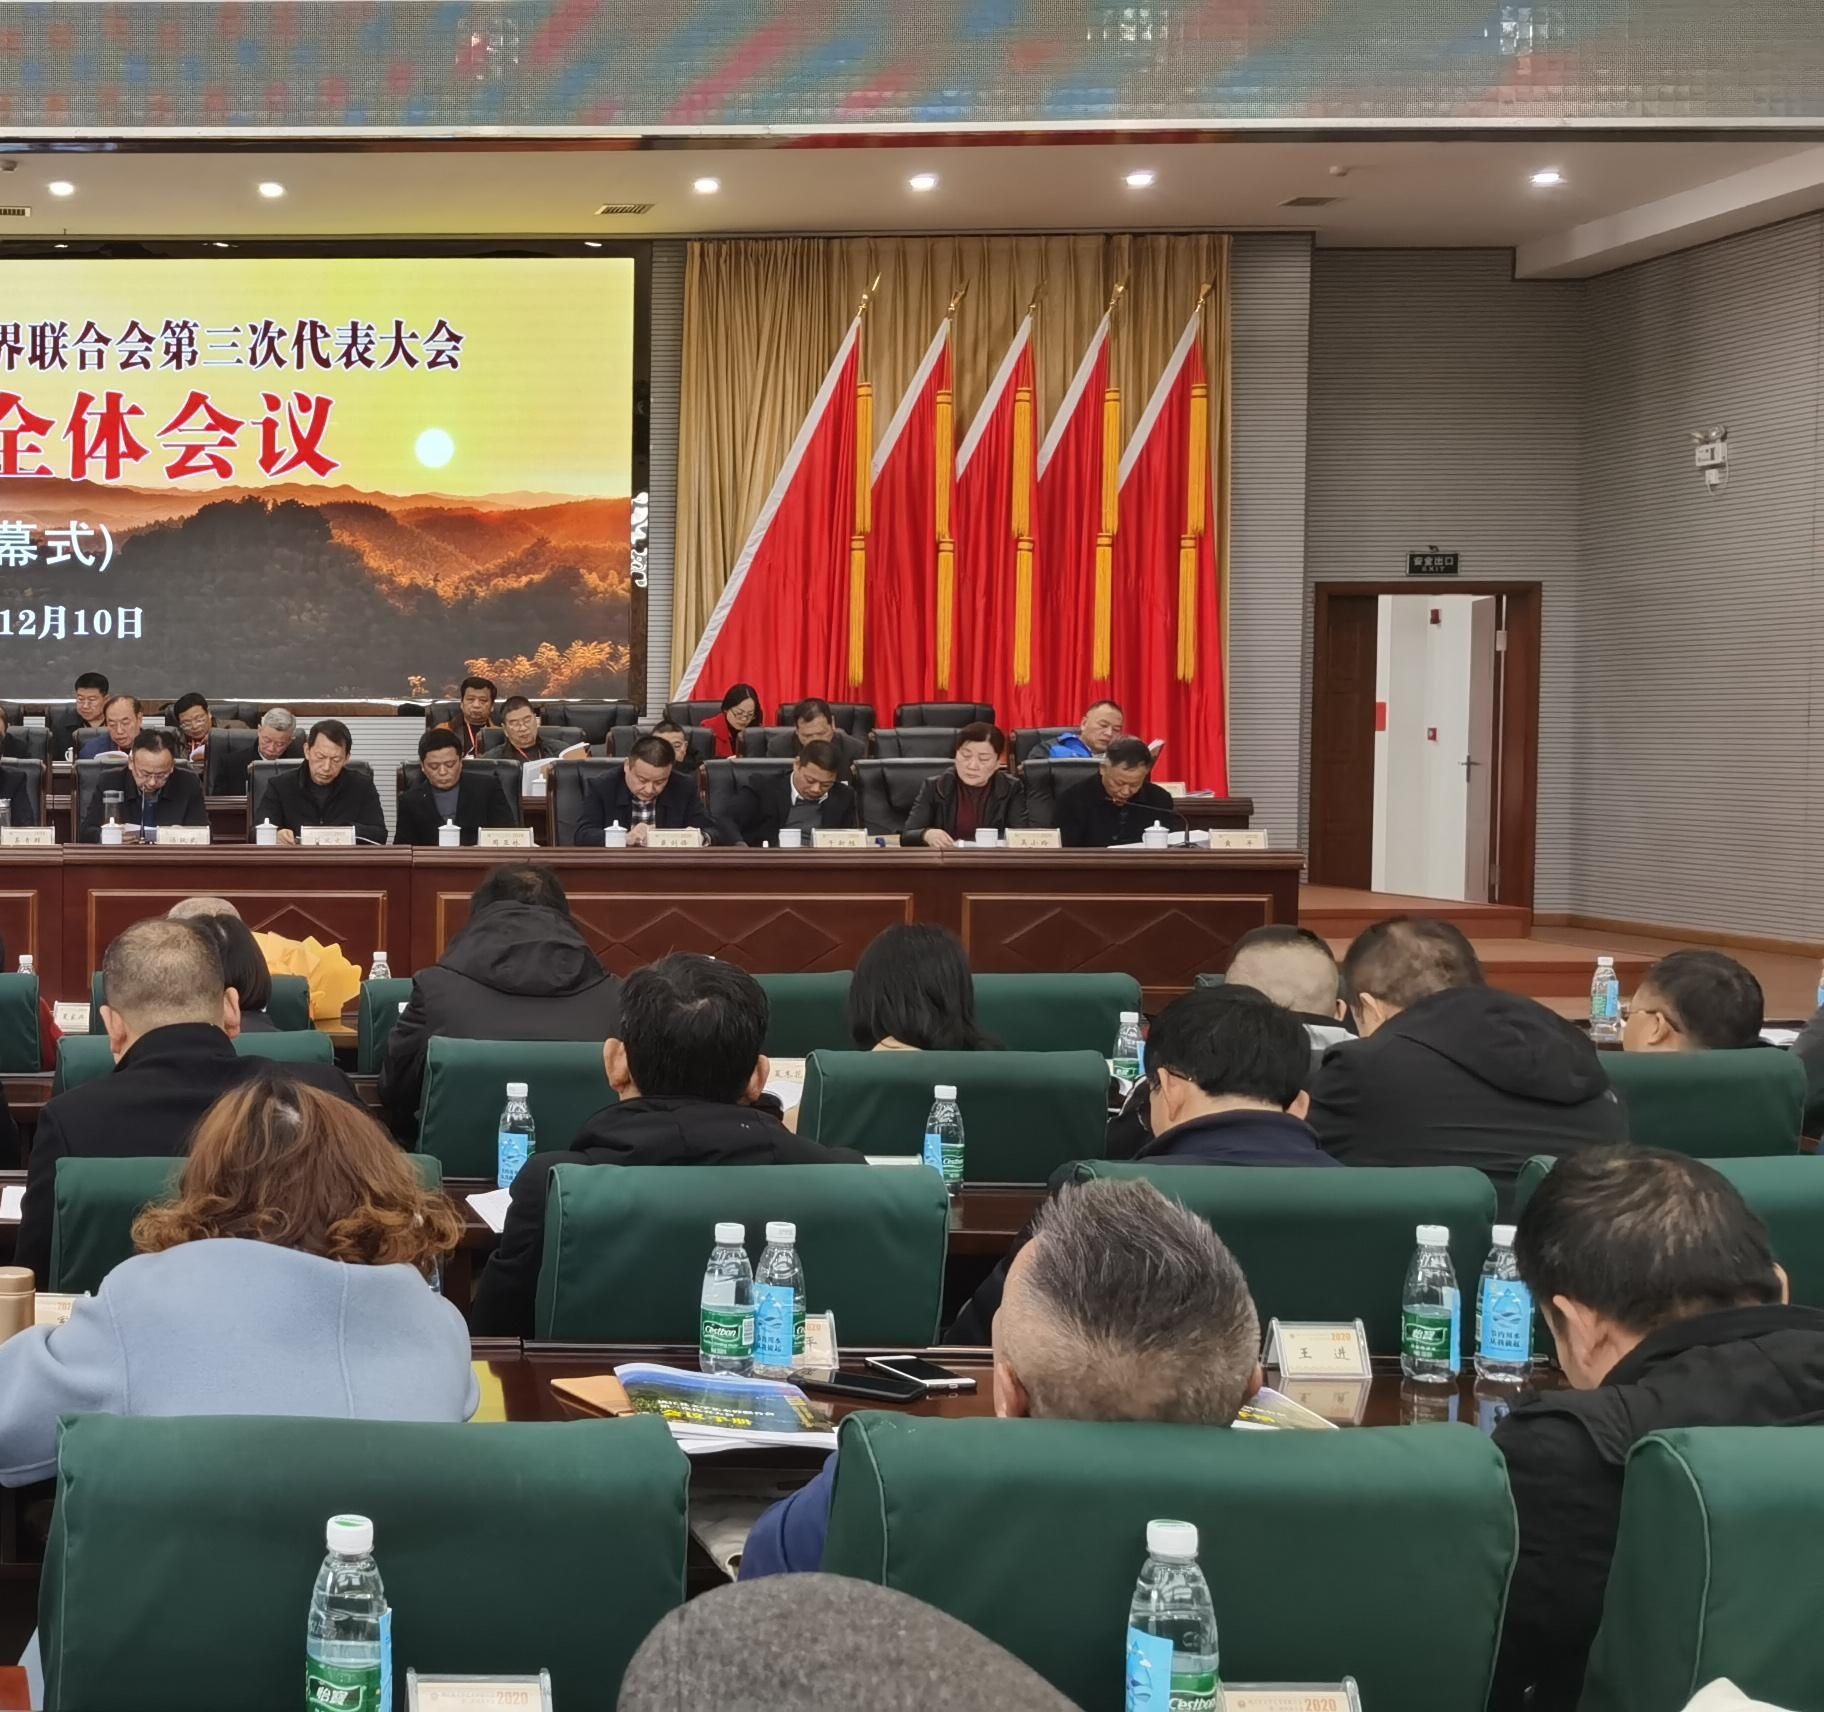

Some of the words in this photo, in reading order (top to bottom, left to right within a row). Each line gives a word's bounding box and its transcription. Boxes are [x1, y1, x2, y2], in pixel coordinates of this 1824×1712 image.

[1413, 556, 1454, 566] 安全出口
[496, 1690, 529, 1705] 2020
[1304, 1698, 1337, 1712] 2020
